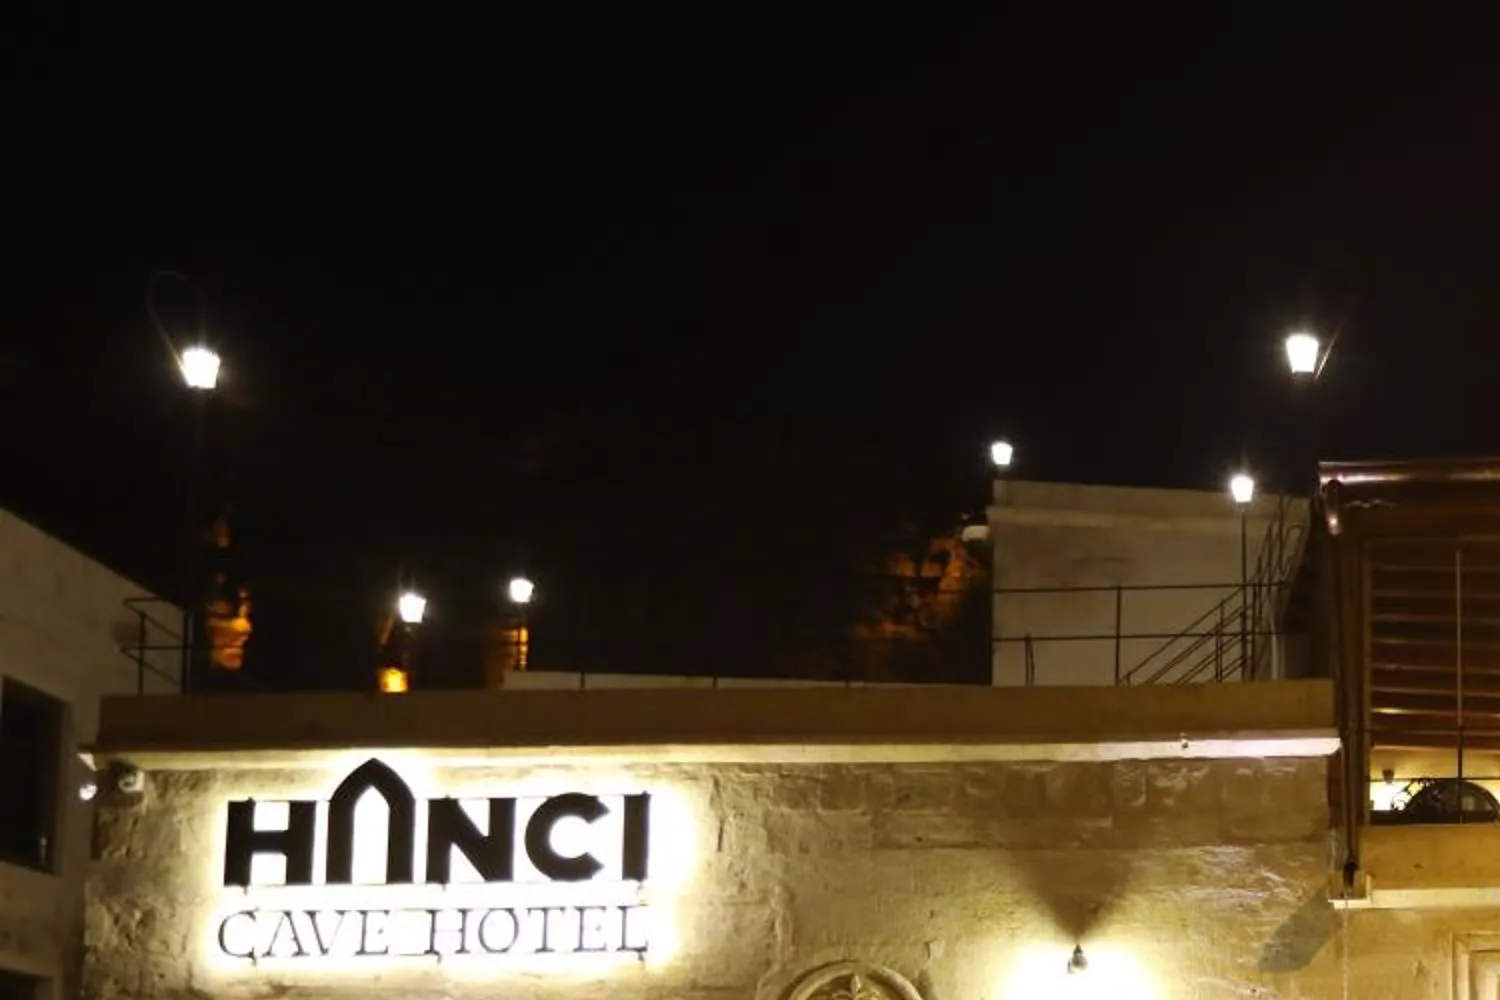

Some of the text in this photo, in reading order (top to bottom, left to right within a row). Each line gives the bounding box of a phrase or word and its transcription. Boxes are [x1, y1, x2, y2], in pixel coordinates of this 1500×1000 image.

[223, 757, 650, 887] HANCI
[217, 904, 649, 958] CAVE HOTEL
